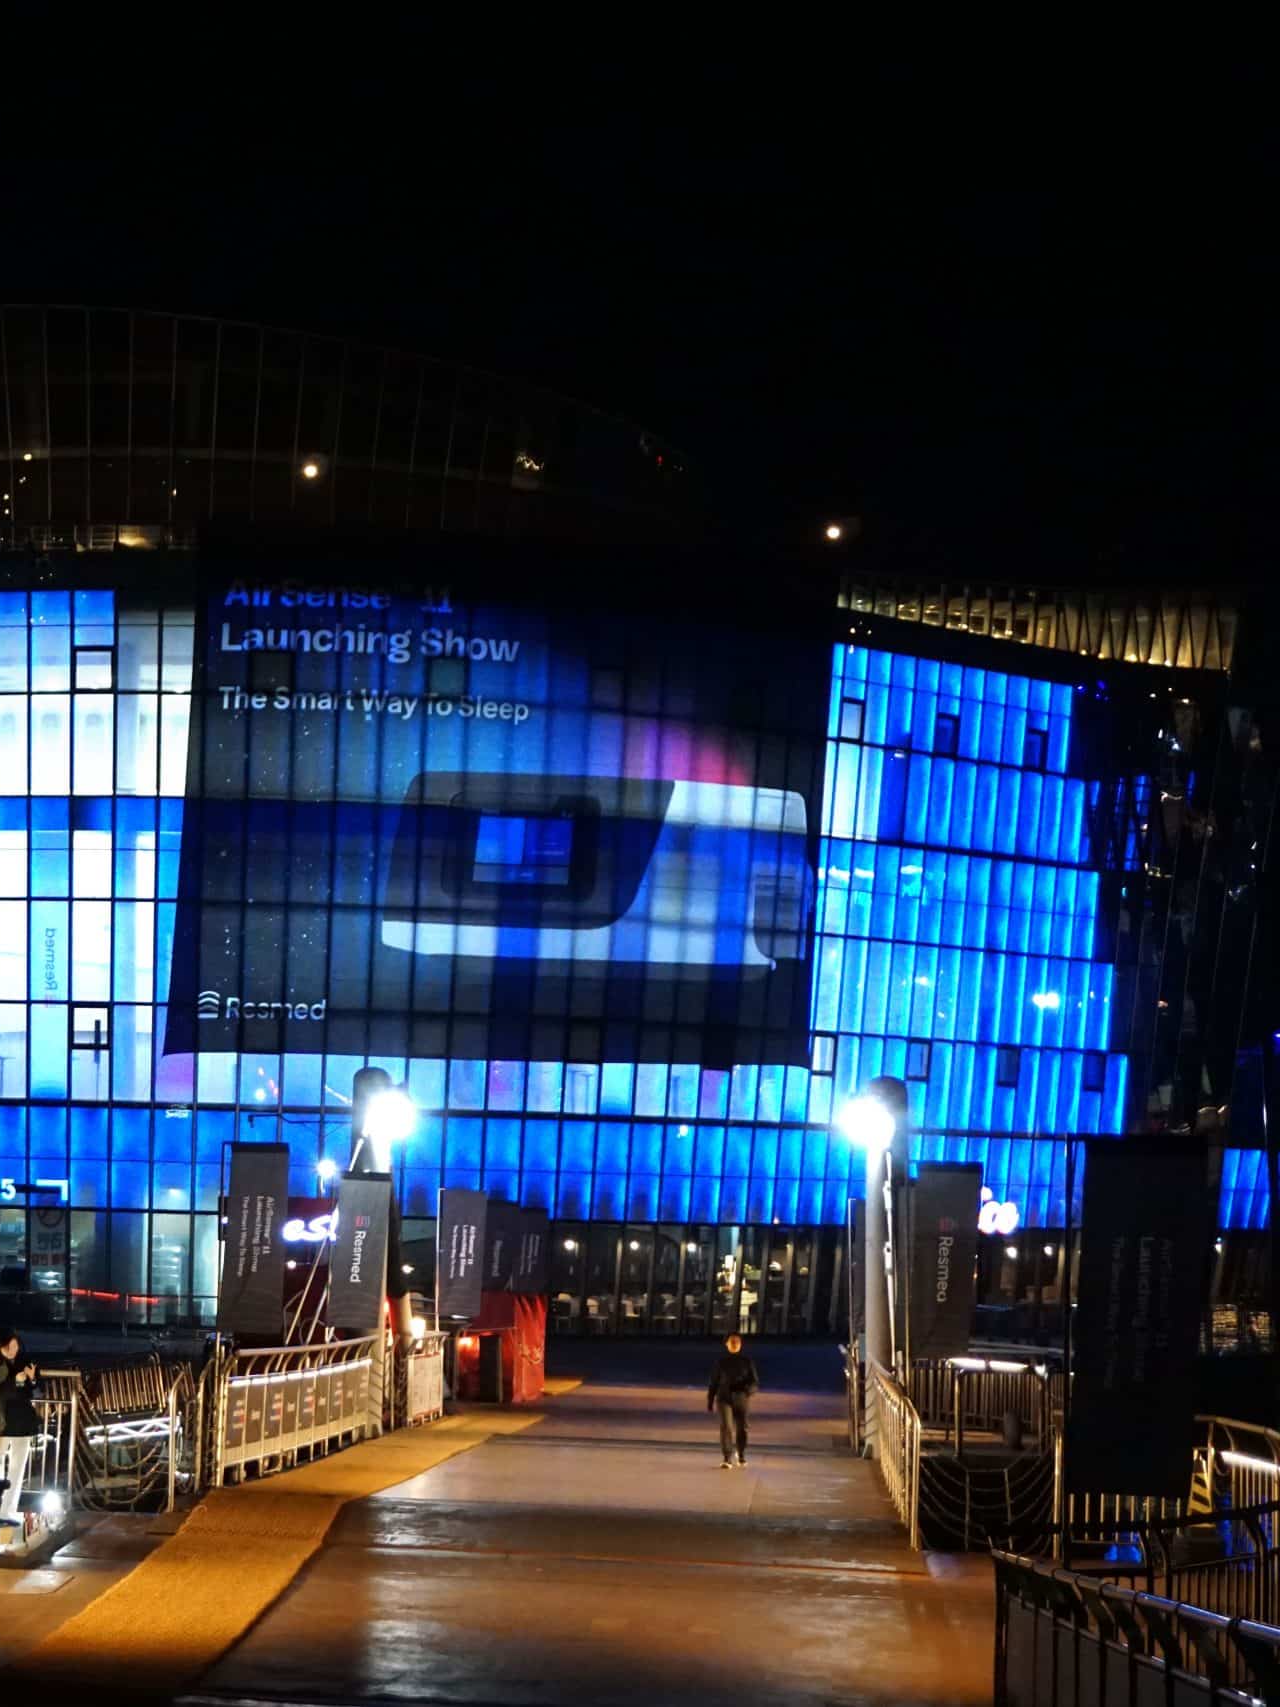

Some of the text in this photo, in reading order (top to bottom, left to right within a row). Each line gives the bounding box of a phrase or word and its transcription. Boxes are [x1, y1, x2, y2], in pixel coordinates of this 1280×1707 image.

[220, 623, 520, 664] Launching Show
[219, 685, 529, 724] The Smart Way To Sleep
[225, 996, 327, 1021] Resmed
[349, 1230, 367, 1283] Resmed
